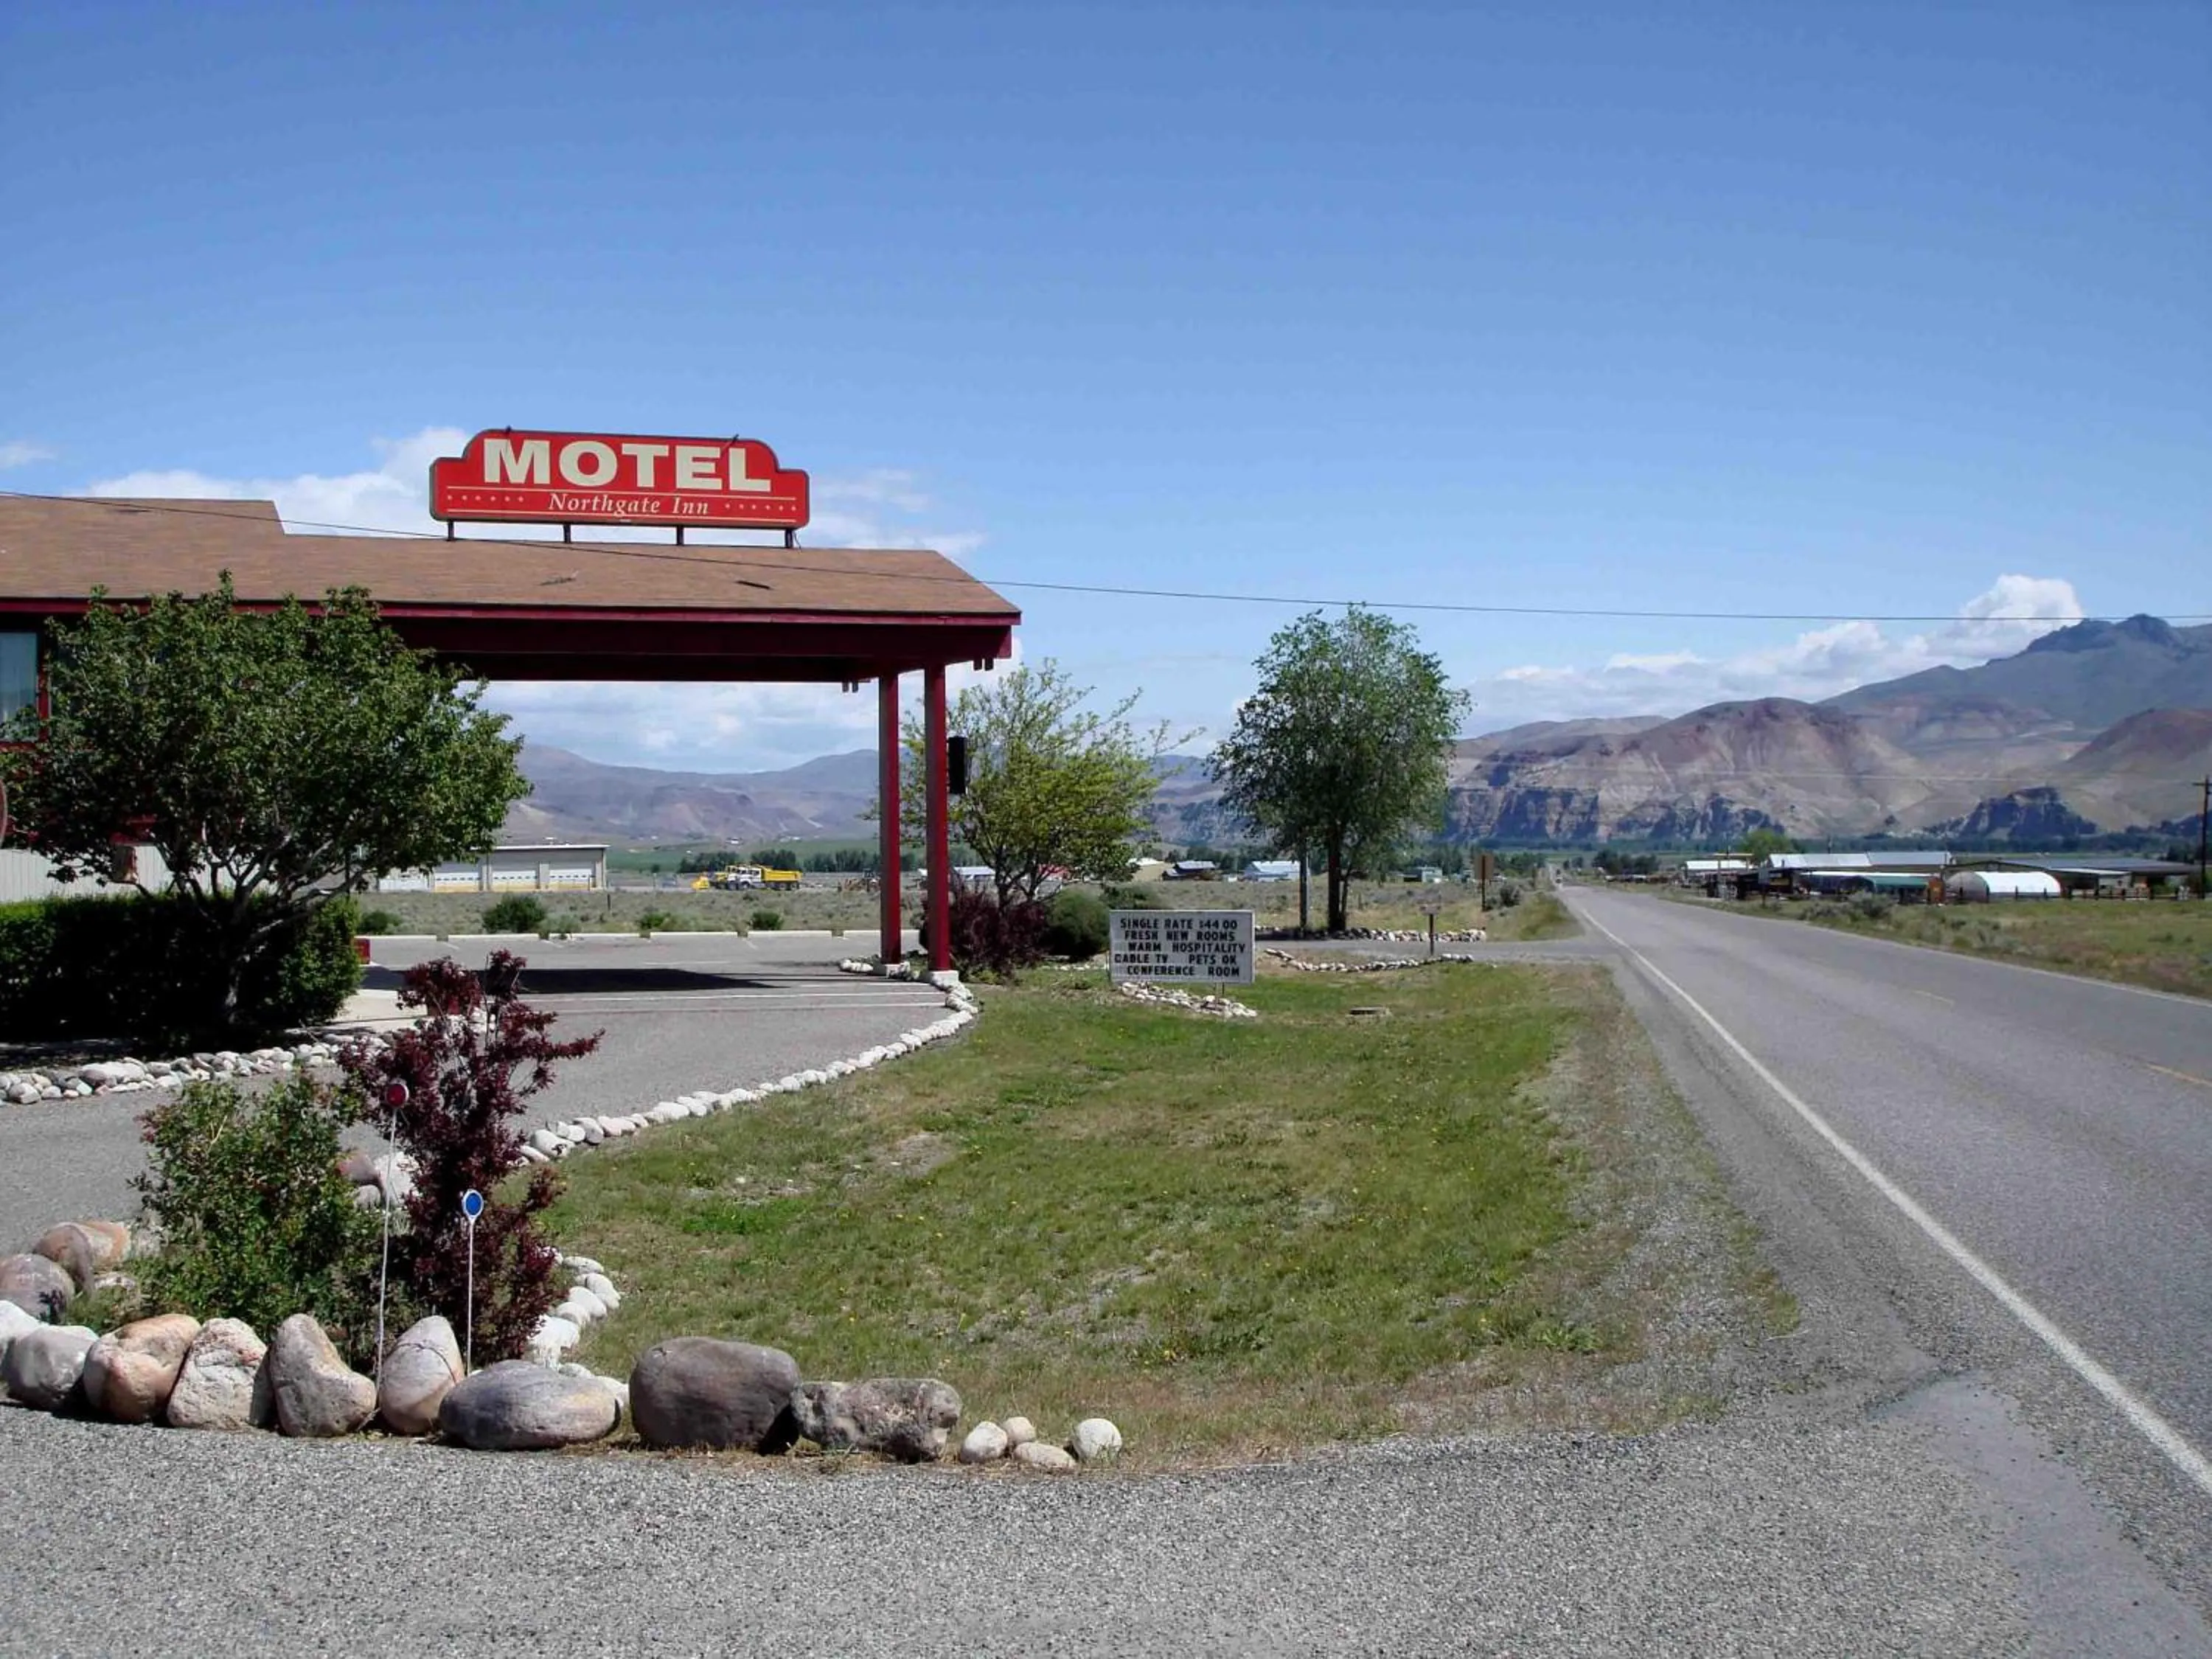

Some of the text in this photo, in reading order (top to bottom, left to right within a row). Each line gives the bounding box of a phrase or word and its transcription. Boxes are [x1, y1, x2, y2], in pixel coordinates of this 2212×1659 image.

[483, 438, 771, 492] MOTEL
[548, 493, 709, 518] Northgate Inn
[1120, 919, 1158, 930] SINGLE
[1164, 919, 1193, 930] RATE
[1124, 930, 1236, 942] FRESH NEW ROOMS
[1128, 942, 1245, 953] WARM HOSPITALITY
[1114, 953, 1237, 965] CABLE TV PETS OK
[1127, 965, 1239, 977] CONFERENCE ROOM
